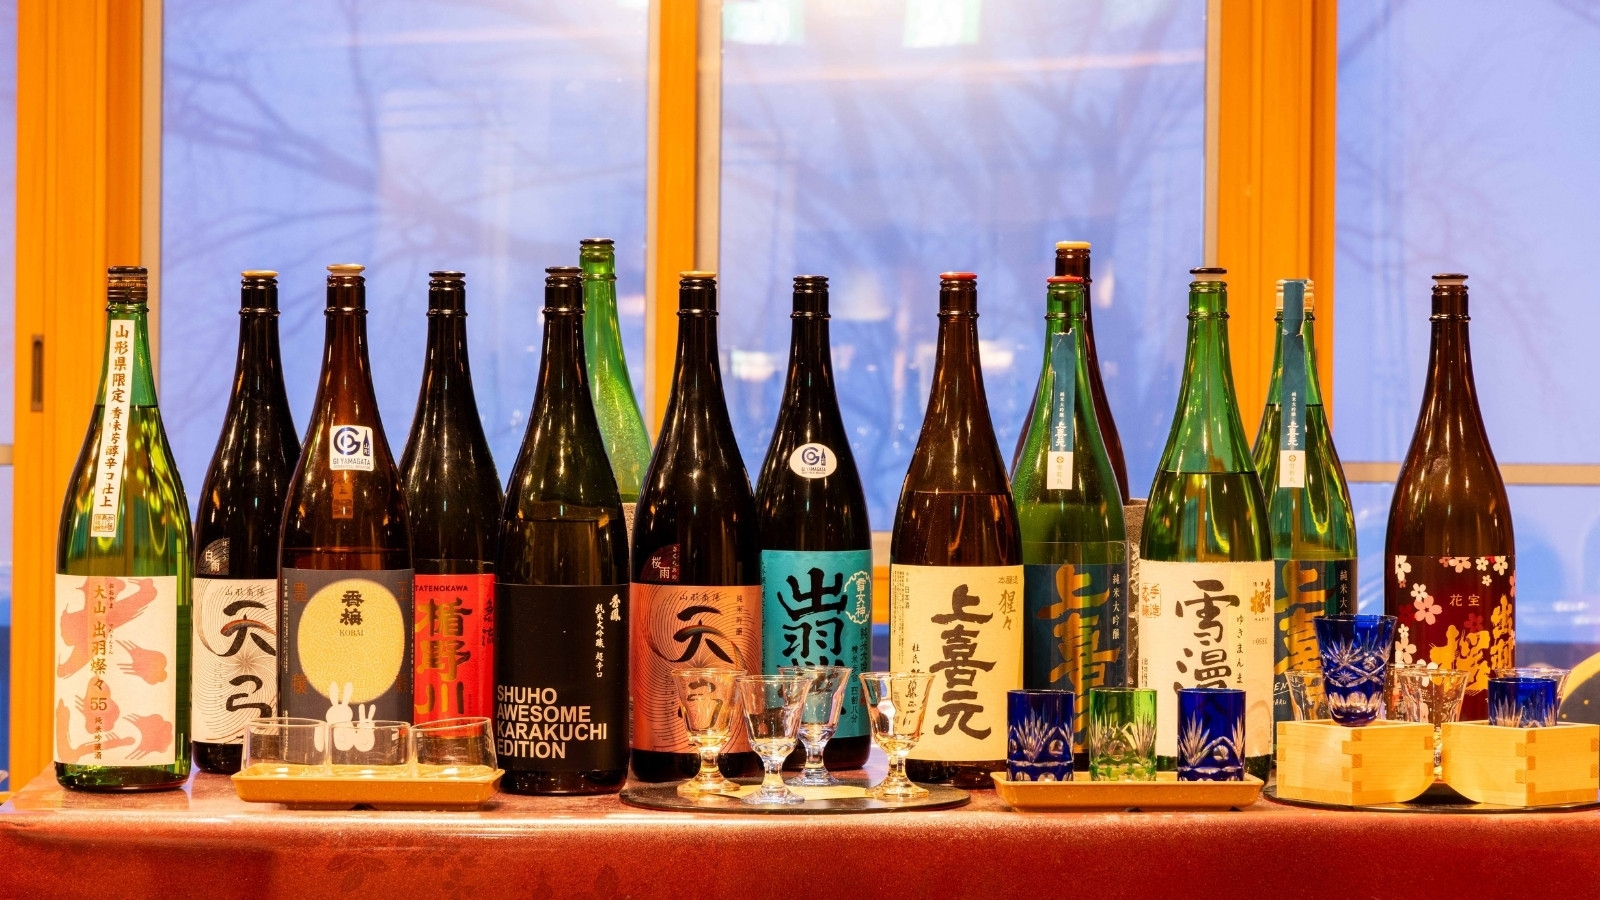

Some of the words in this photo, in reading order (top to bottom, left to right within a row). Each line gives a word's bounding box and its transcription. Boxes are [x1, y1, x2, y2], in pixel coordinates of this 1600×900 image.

[111, 324, 129, 403] 山形県限定
[1286, 420, 1300, 447] 上喜元
[341, 458, 371, 466] YAMAGATA
[652, 556, 670, 579] 桜雨
[93, 584, 107, 614] 大山
[340, 590, 364, 625] 香梅
[855, 577, 867, 616] 雪女神
[1112, 573, 1121, 640] 純米大吟醸
[339, 629, 365, 637] KOBAI
[595, 603, 605, 649] 純米大吟醸
[1173, 579, 1240, 696] 雪漫
[90, 621, 107, 691] 出羽燦々
[414, 597, 473, 715] 楯野川
[595, 651, 604, 678] 超辛口
[929, 583, 997, 741] 上喜元
[90, 697, 107, 711] 55
[497, 685, 557, 704] SHUHO
[851, 686, 859, 723] 四割八分
[497, 704, 591, 723] AWESOME
[497, 721, 607, 741] KARAKUCHI
[497, 739, 566, 758] EDITION
